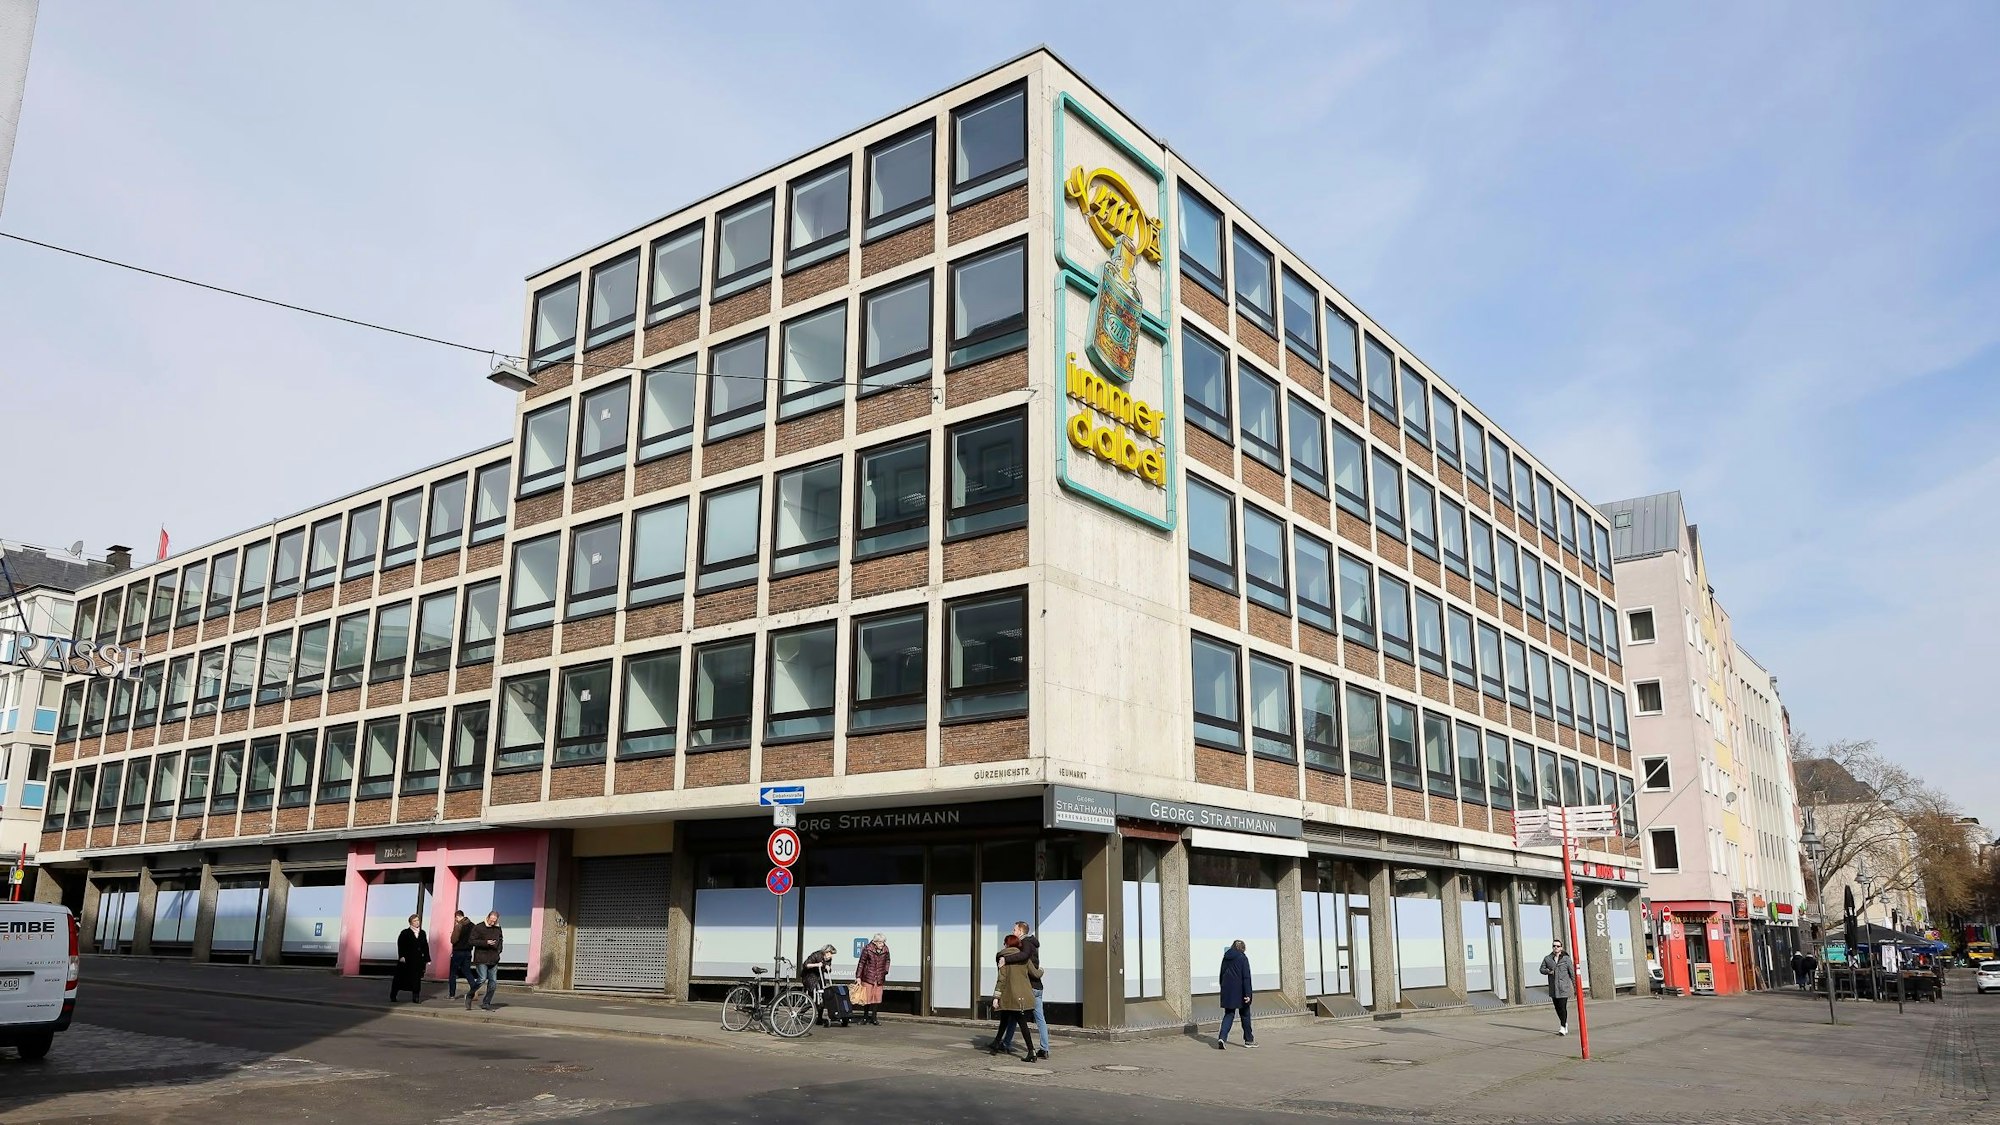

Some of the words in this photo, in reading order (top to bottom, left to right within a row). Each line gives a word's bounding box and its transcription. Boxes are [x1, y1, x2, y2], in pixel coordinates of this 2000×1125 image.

[1090, 184, 1139, 241] 4711
[1066, 352, 1167, 439] immer
[1067, 406, 1167, 487] dabei
[0, 630, 146, 682] RASSE
[799, 818, 831, 832] ORG
[838, 810, 960, 829] STRATHMANN
[1056, 800, 1115, 816] STRATHMANN
[1150, 801, 1195, 822] GEORG
[1200, 810, 1278, 833] STRATHMANN
[775, 838, 793, 856] 30
[1593, 897, 1606, 937] KIOSK
